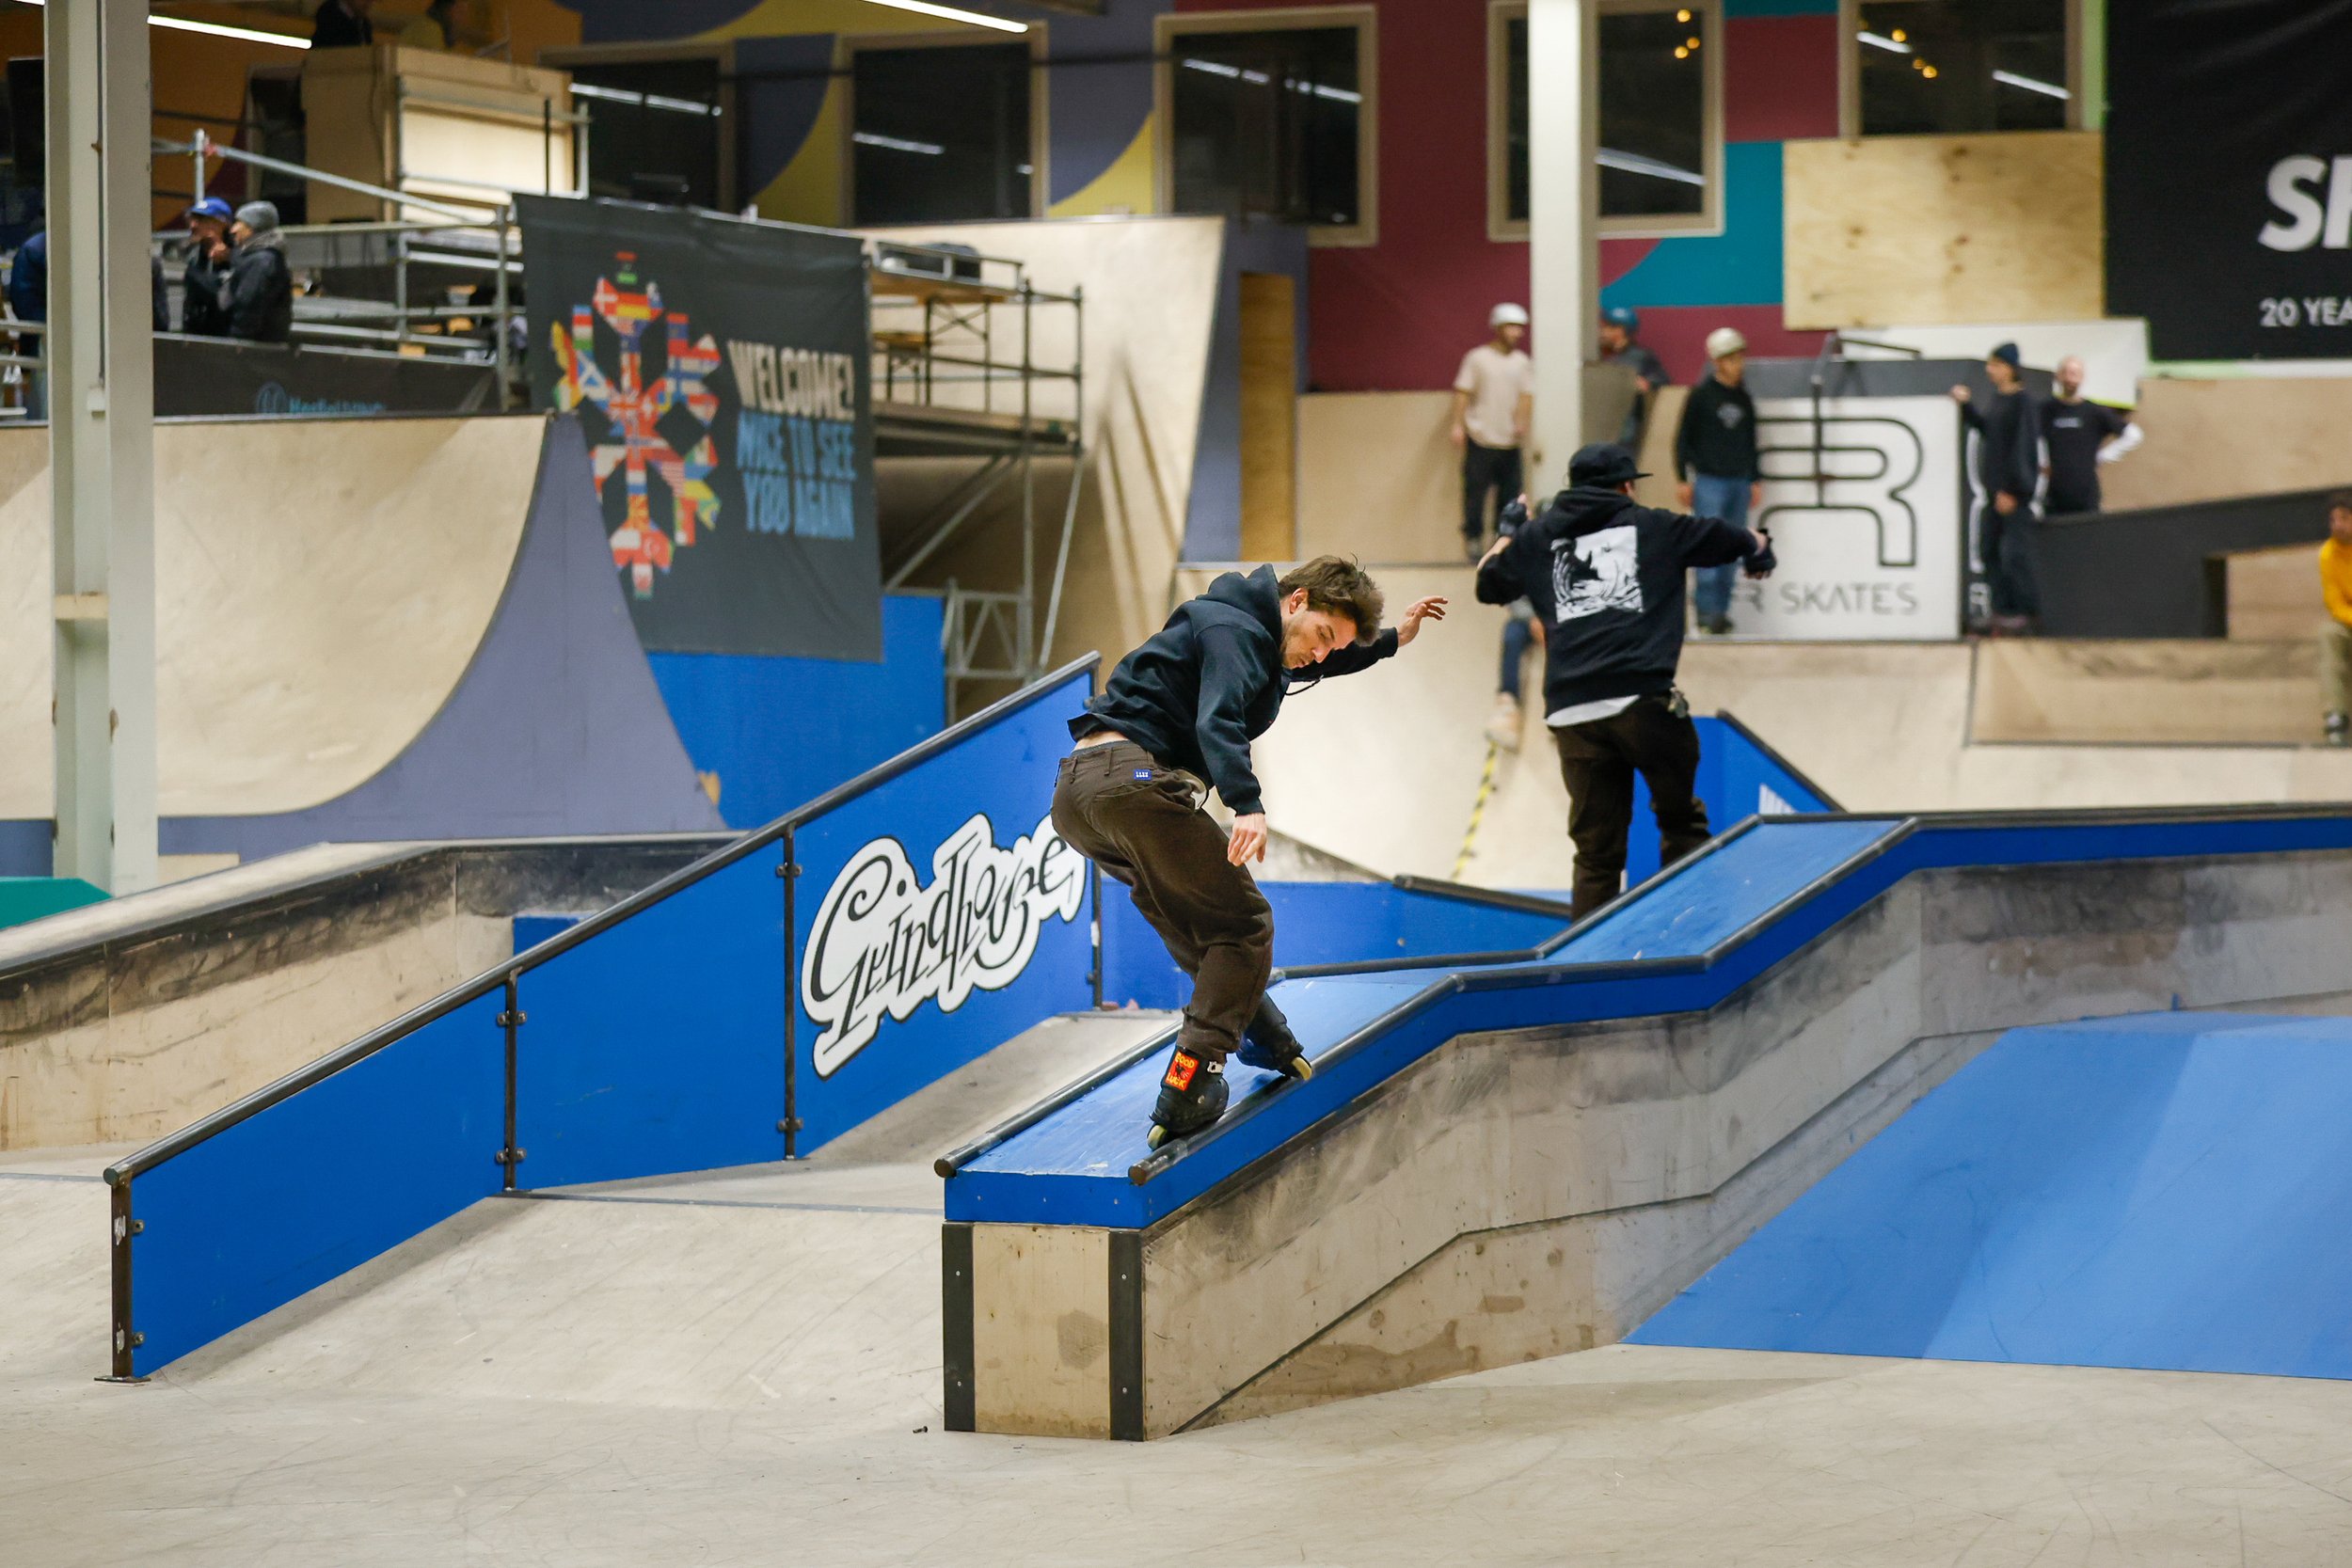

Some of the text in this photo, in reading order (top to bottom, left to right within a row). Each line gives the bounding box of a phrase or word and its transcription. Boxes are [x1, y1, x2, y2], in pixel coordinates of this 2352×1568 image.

[2260, 297, 2299, 327] 20
[727, 340, 855, 420] WELCOME!
[737, 410, 857, 481] NICE TO SEE
[743, 472, 855, 540] YOU AGAIN
[1779, 580, 1917, 614] SKATES
[810, 831, 1075, 1055] Grindhouse
[1168, 1073, 1187, 1087] LUCK
[1175, 1052, 1195, 1069] GOOD
